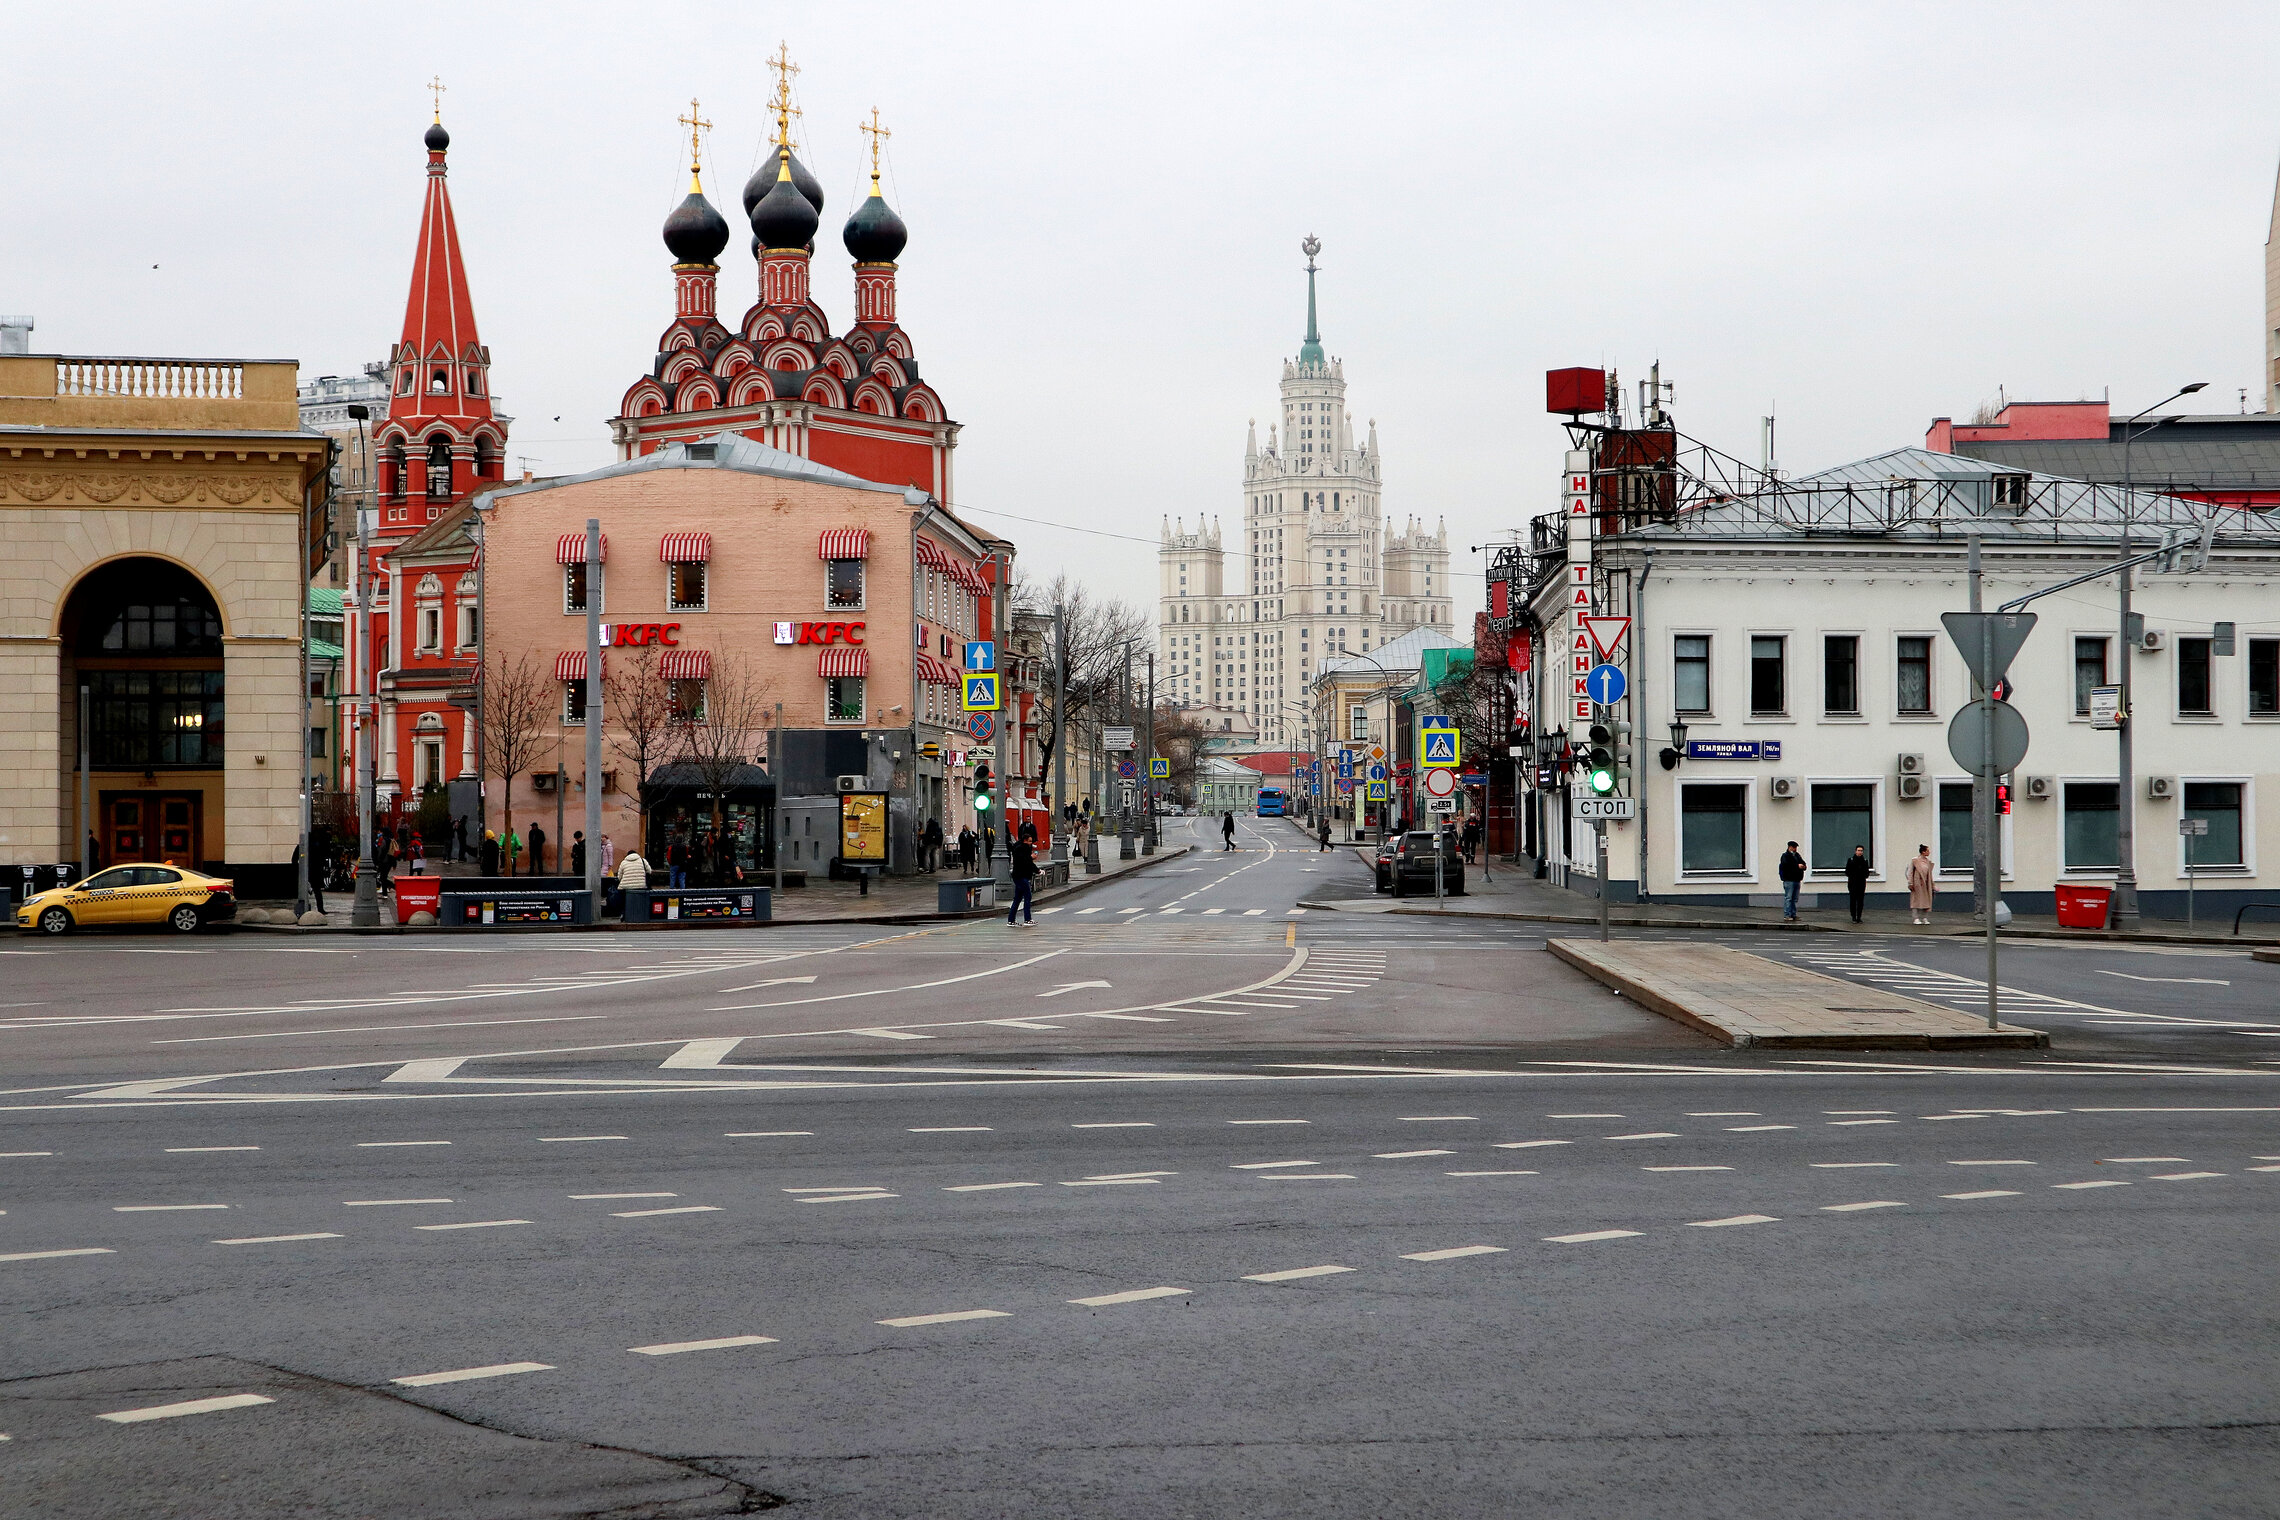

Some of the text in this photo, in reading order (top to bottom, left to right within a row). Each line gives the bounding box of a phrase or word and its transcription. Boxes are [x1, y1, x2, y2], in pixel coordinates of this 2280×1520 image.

[1573, 476, 1587, 514] НА
[613, 623, 681, 647] KFC
[797, 621, 866, 645] KFC
[1573, 566, 1589, 717] ТАГАНКЕ
[1697, 744, 1736, 752] ЗЕМЛЯНОЙ
[1580, 801, 1626, 815] СТОП
